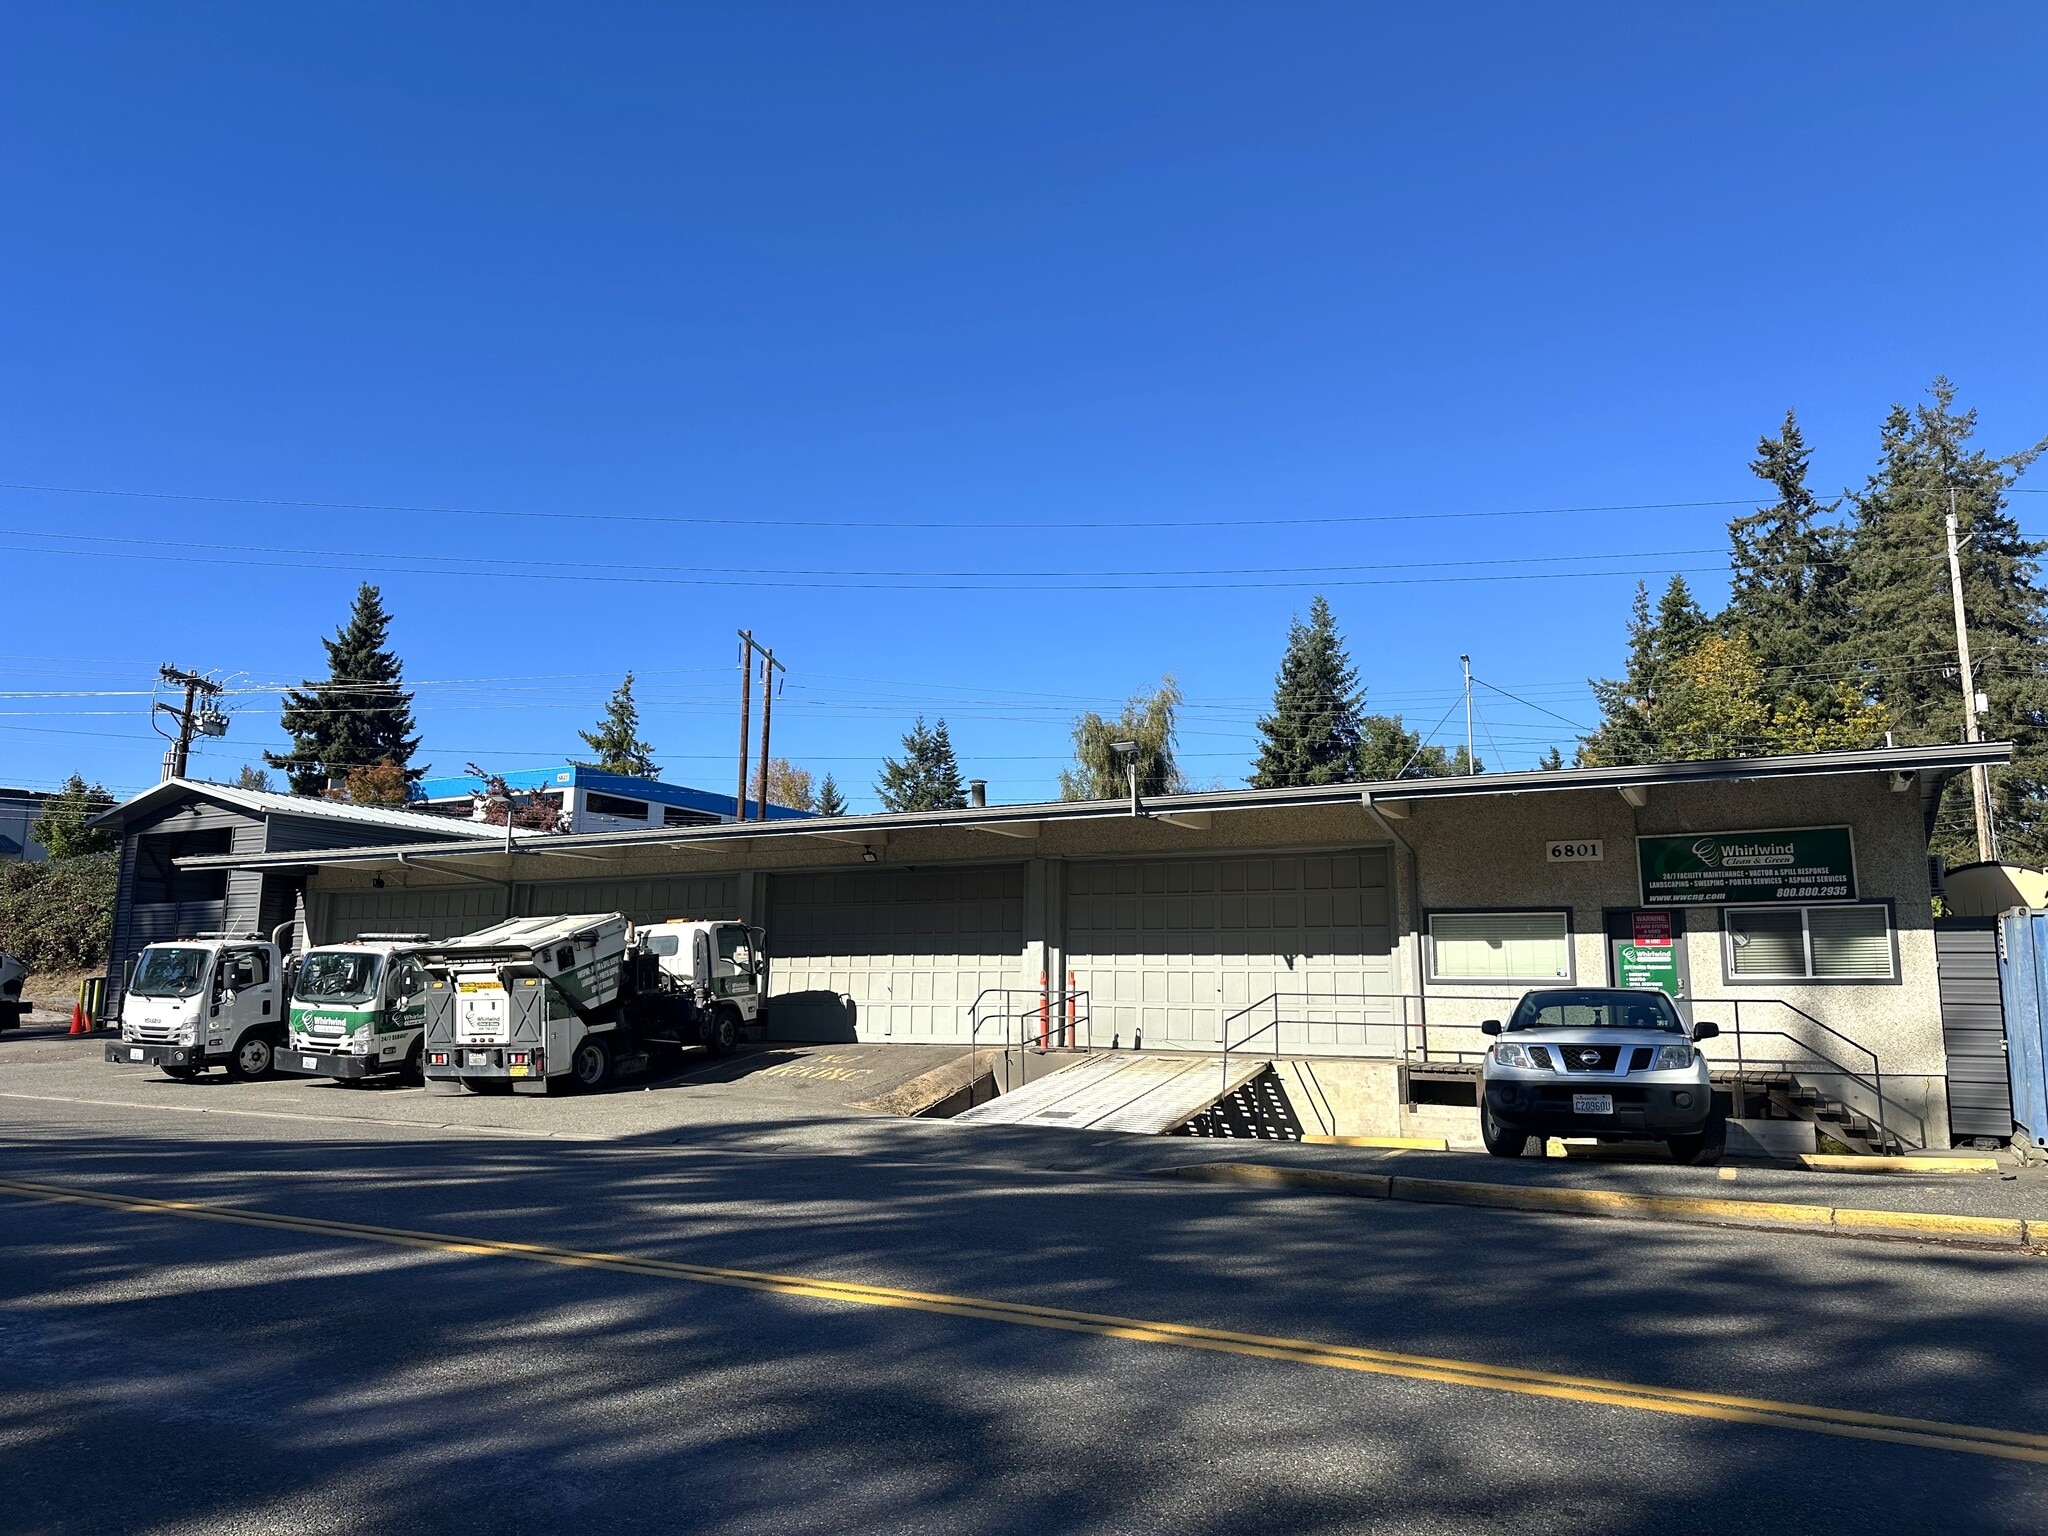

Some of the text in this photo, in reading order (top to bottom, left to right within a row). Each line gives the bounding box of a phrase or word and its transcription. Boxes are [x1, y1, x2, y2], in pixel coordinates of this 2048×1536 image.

[1552, 844, 1598, 857] 6801
[1721, 843, 1794, 857] Whirlwind
[1726, 857, 1750, 866] Clean
[1764, 856, 1790, 864] Green
[1662, 872, 1676, 880] 24/7
[1677, 871, 1702, 880] FACILITY
[1703, 870, 1744, 879] MAINTENANCE
[1749, 869, 1773, 877] VACTOR
[1780, 868, 1797, 876] SPILL
[1797, 867, 1829, 875] RESPONSE
[1649, 875, 1847, 889] LANDSCAPING SWEEPING PORTER SERVICES ASPHALT SERVICES
[1776, 886, 1848, 897] 800.800.2935
[1649, 893, 1726, 902] www.wwcng.com
[314, 1016, 347, 1026] Whirlwind
[404, 1013, 426, 1021] Whirlw
